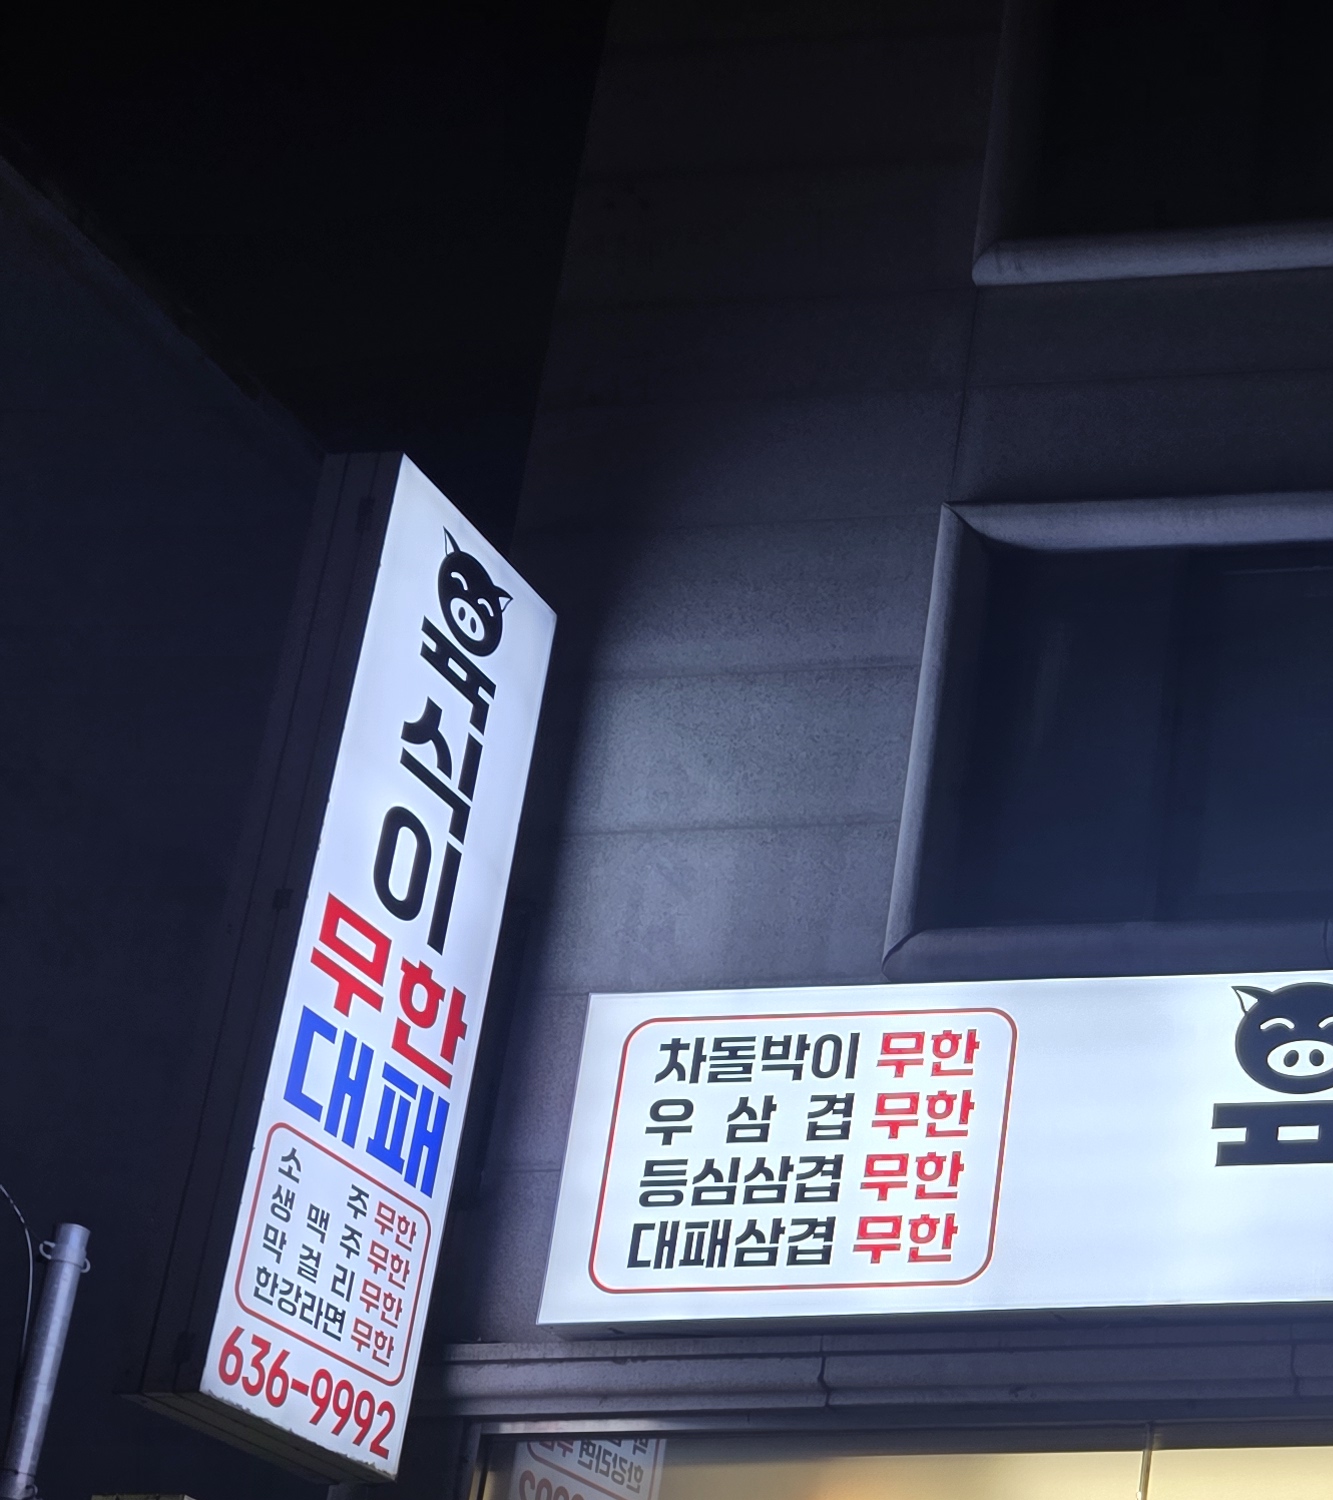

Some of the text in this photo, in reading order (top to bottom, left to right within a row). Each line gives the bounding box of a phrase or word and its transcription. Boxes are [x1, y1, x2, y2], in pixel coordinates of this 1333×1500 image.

[310, 892, 468, 1090] 무한
[654, 1028, 981, 1084] 차돌박이 무한
[283, 1005, 450, 1198] 대패
[871, 1089, 975, 1139] 무한
[638, 1151, 964, 1207] 등심삼겹 무한
[374, 1201, 417, 1251] 무한
[627, 1213, 958, 1269] 대패삼겹 무한
[367, 1239, 410, 1290] 무한
[253, 1265, 395, 1367] 한강라면 무한
[359, 1279, 403, 1329] 무한
[218, 1326, 396, 1460] 636-9992
